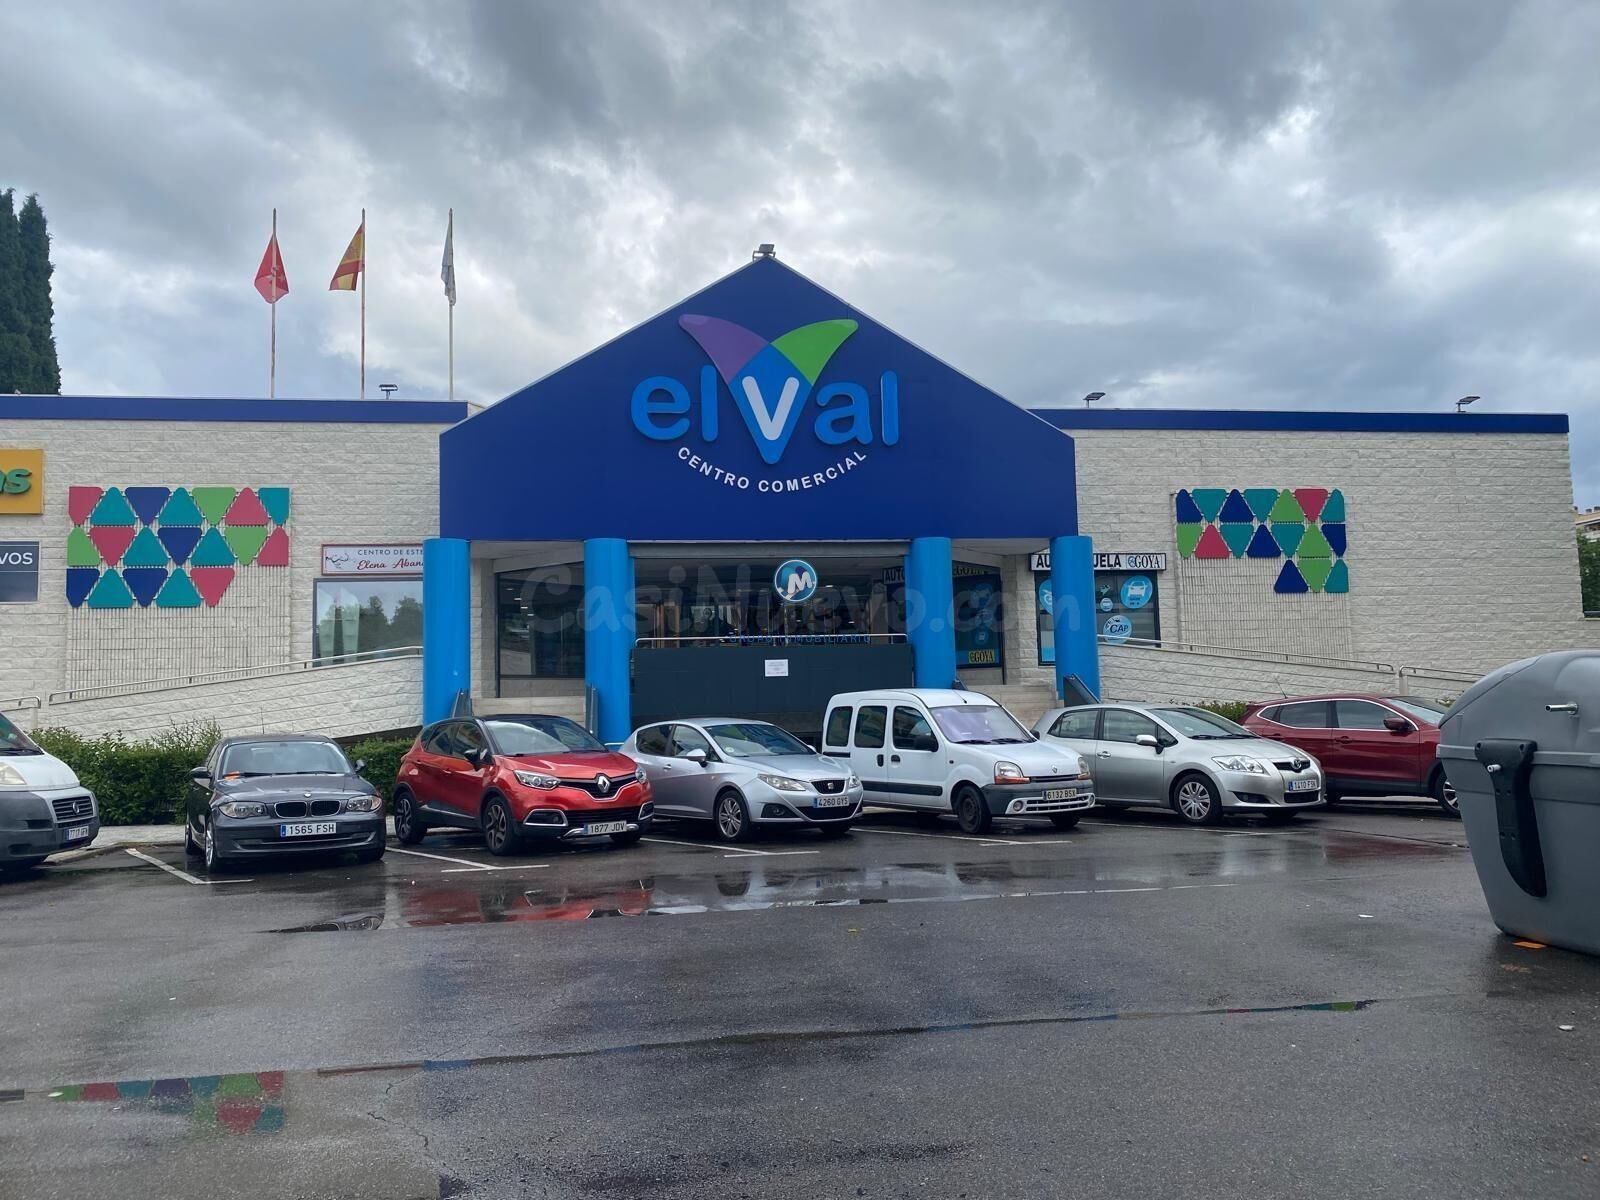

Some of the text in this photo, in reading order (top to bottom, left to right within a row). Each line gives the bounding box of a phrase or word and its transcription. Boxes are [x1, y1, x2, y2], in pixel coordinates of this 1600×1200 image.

[677, 446, 868, 493] CENTRO COMERCIAL
[1109, 624, 1129, 634] CAP
[1047, 790, 1064, 799] 6132
[818, 797, 836, 806] 4260
[290, 823, 335, 835] 1565 FSH
[590, 822, 625, 833] 1877 JDV
